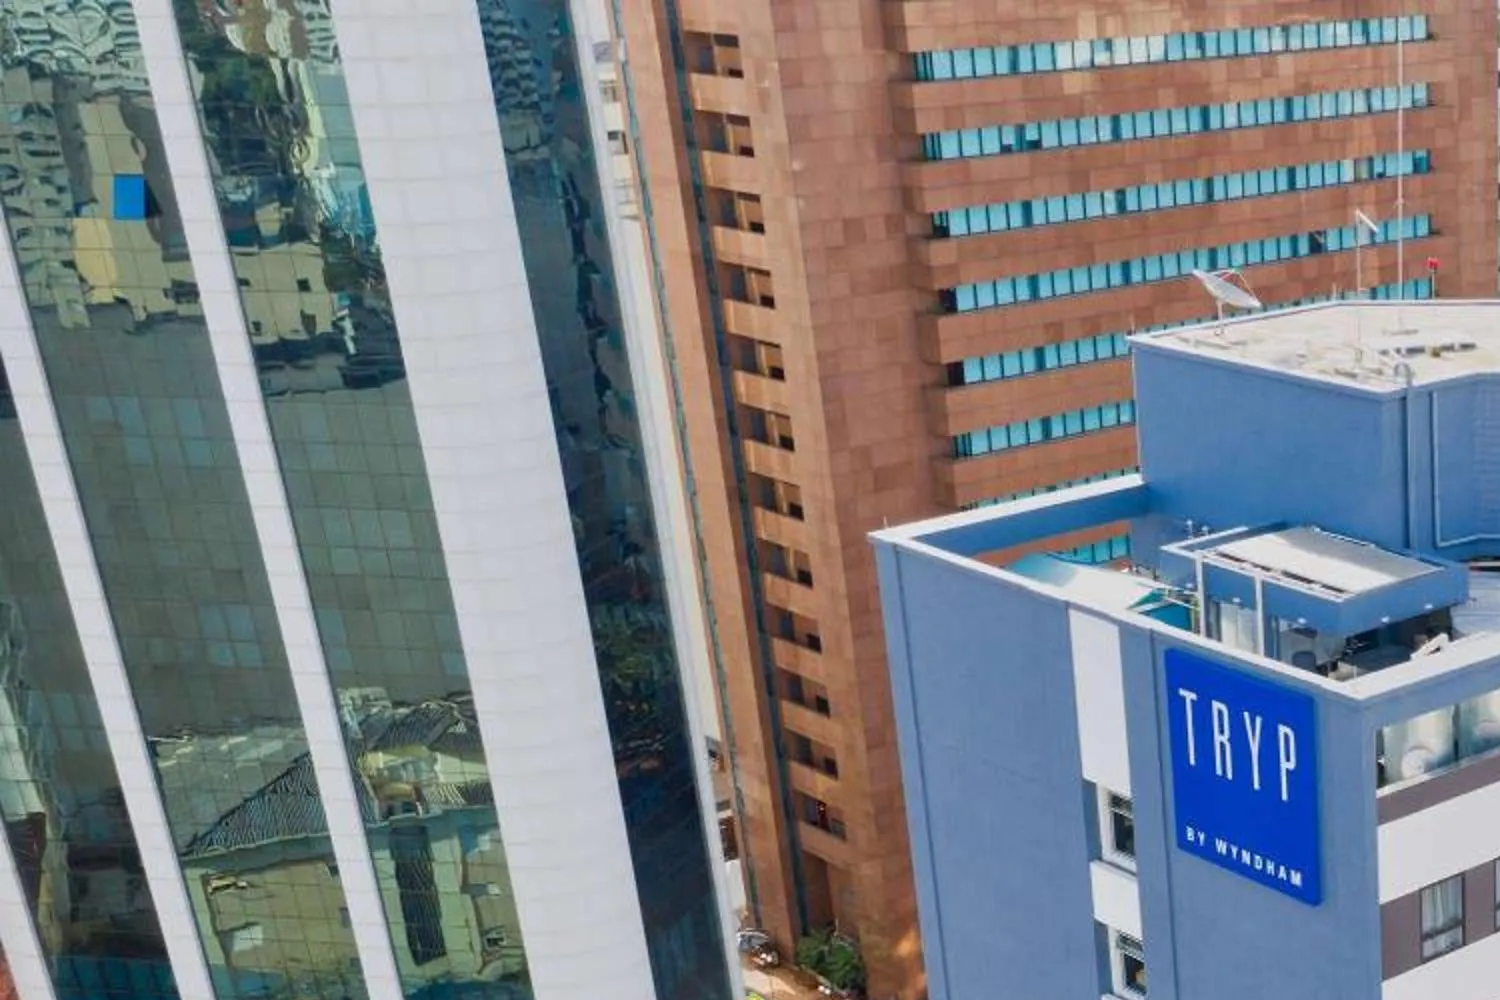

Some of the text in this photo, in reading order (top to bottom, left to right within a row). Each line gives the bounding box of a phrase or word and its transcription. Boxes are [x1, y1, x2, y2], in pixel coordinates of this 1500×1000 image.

[1178, 687, 1297, 801] TRYP
[1186, 826, 1303, 888] BY WYNDHAM
